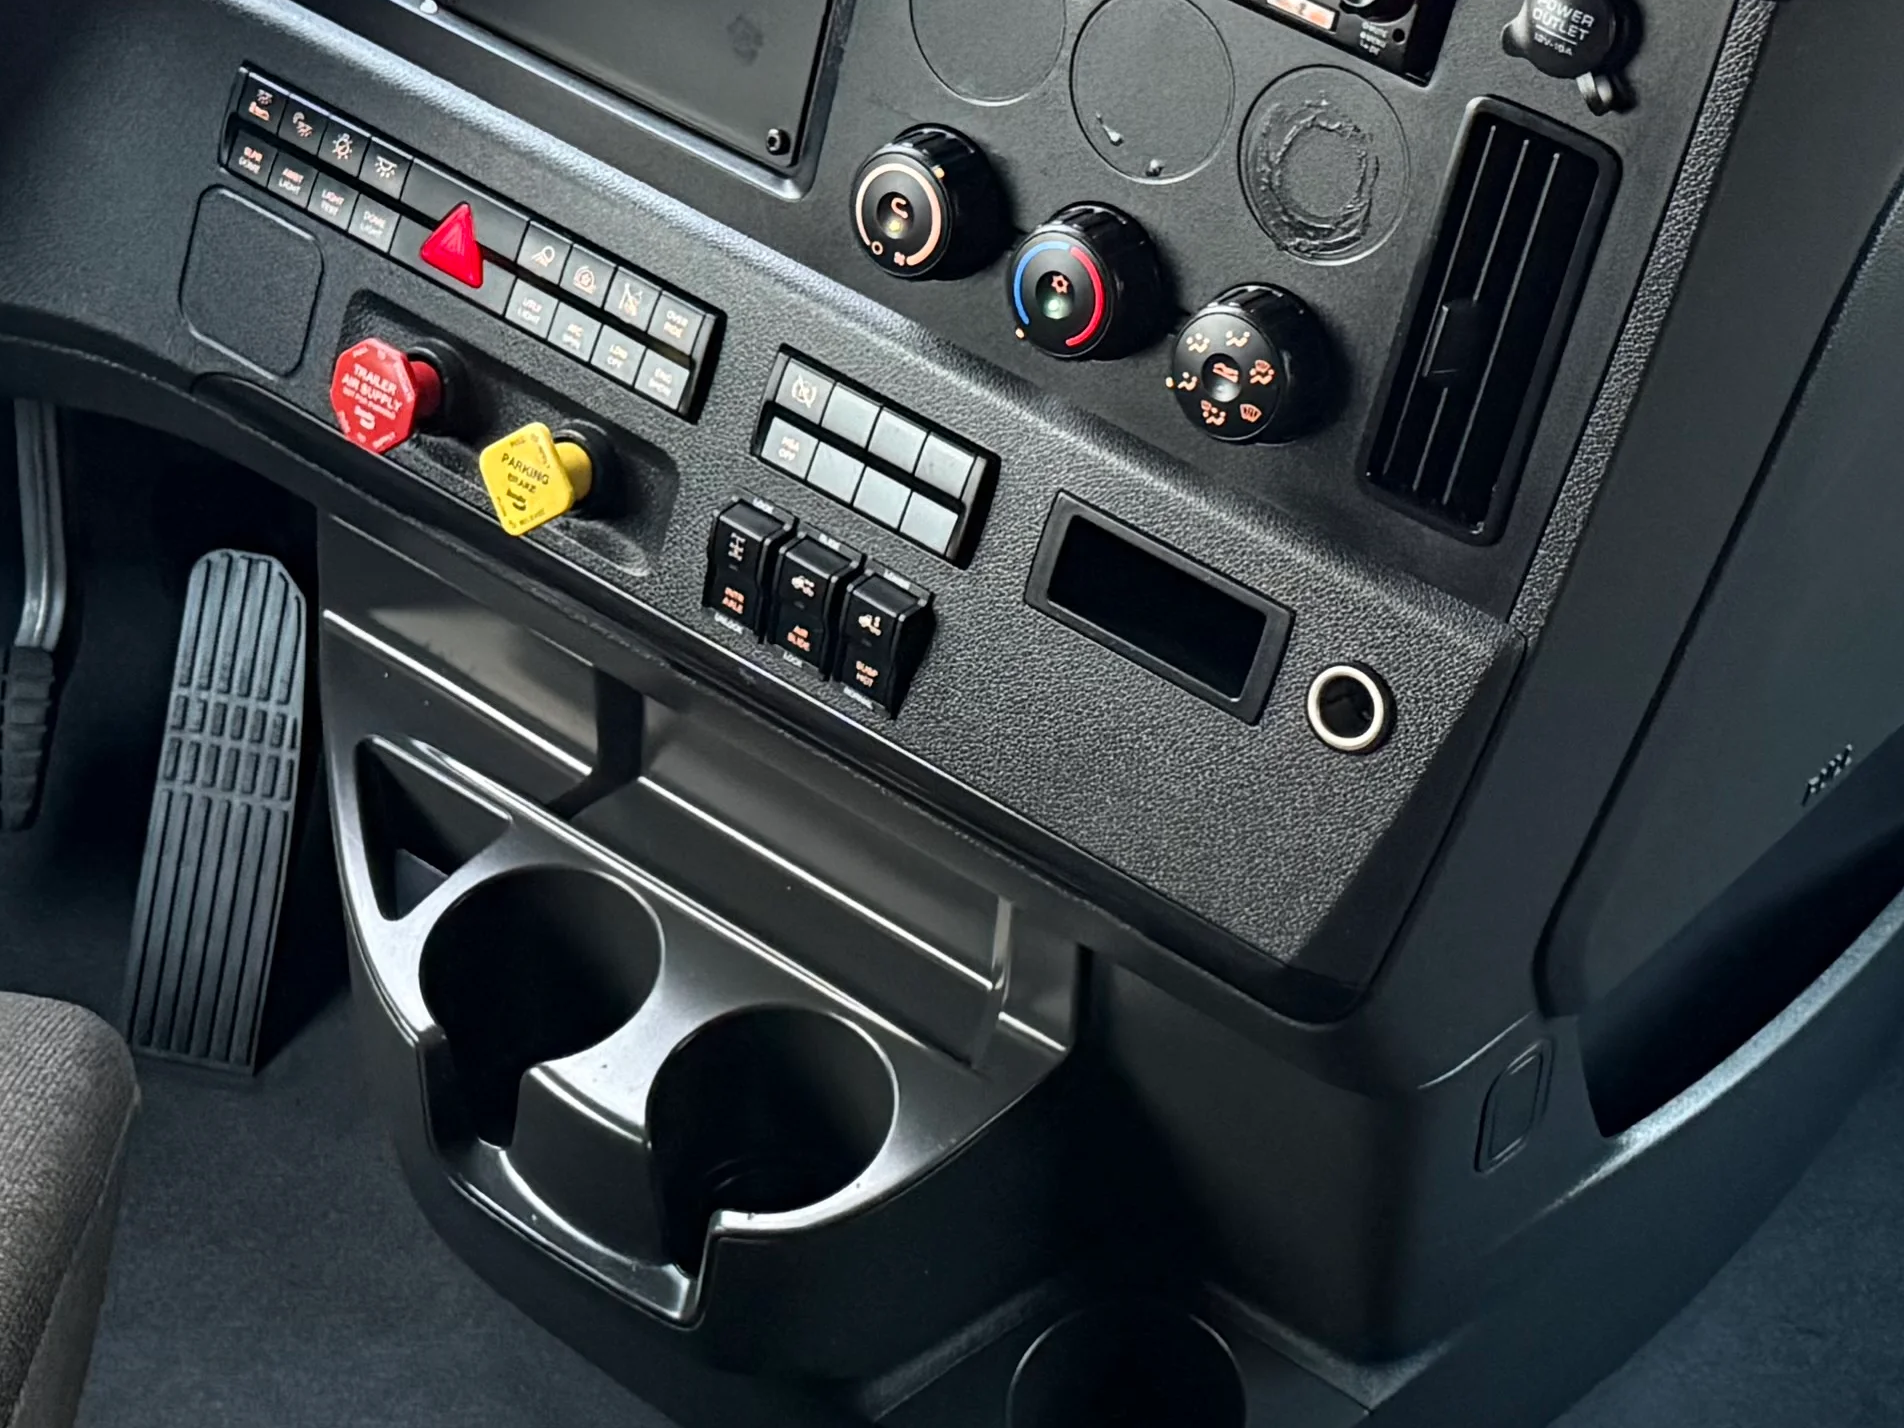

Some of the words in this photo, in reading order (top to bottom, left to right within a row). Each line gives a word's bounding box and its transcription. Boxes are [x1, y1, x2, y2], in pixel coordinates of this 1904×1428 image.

[1531, 6, 1590, 41] OUTLET
[342, 375, 359, 393] AIR
[360, 383, 403, 411] SUPPLY
[353, 363, 397, 396] TRAILER
[501, 453, 550, 485] PARKING
[714, 613, 742, 634] UNLOCK
[783, 652, 803, 668] LOCK
